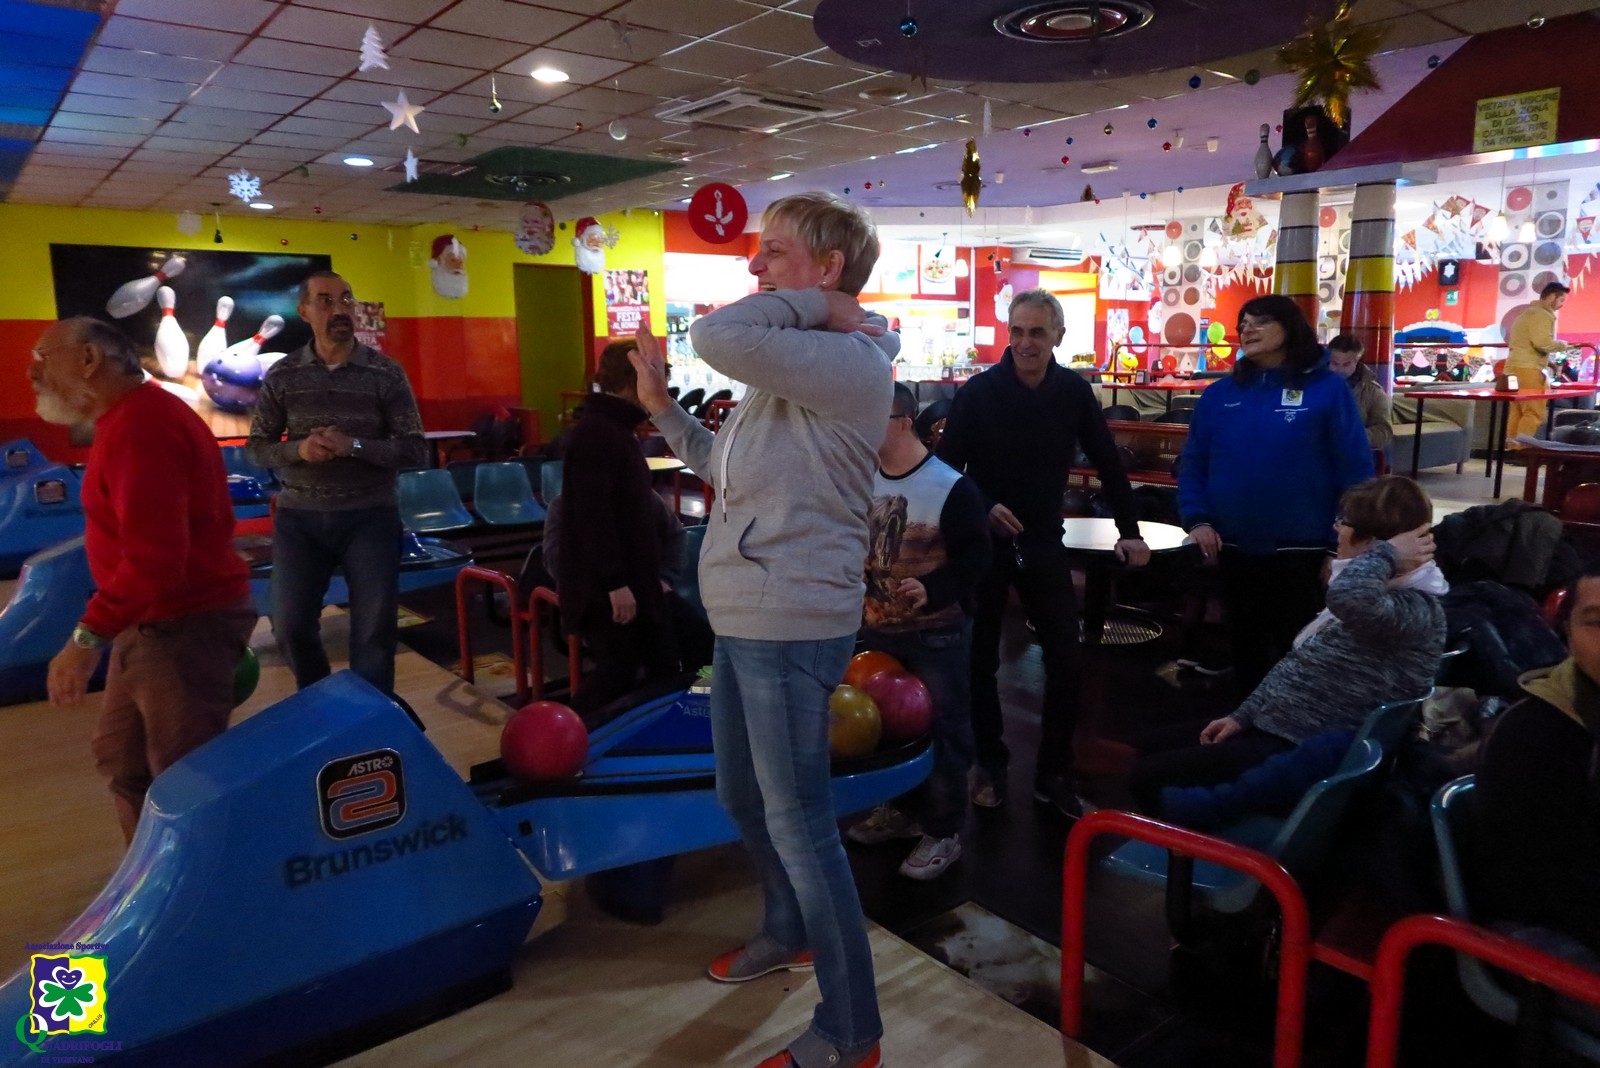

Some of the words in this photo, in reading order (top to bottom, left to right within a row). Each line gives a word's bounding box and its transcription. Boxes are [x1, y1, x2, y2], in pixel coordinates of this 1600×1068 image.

[1485, 109, 1516, 120] DALLA
[1492, 119, 1502, 128] DI
[616, 311, 642, 322] FESTA
[347, 755, 394, 777] ASTRO
[327, 769, 400, 831] 2
[284, 811, 468, 888] Brunswick
